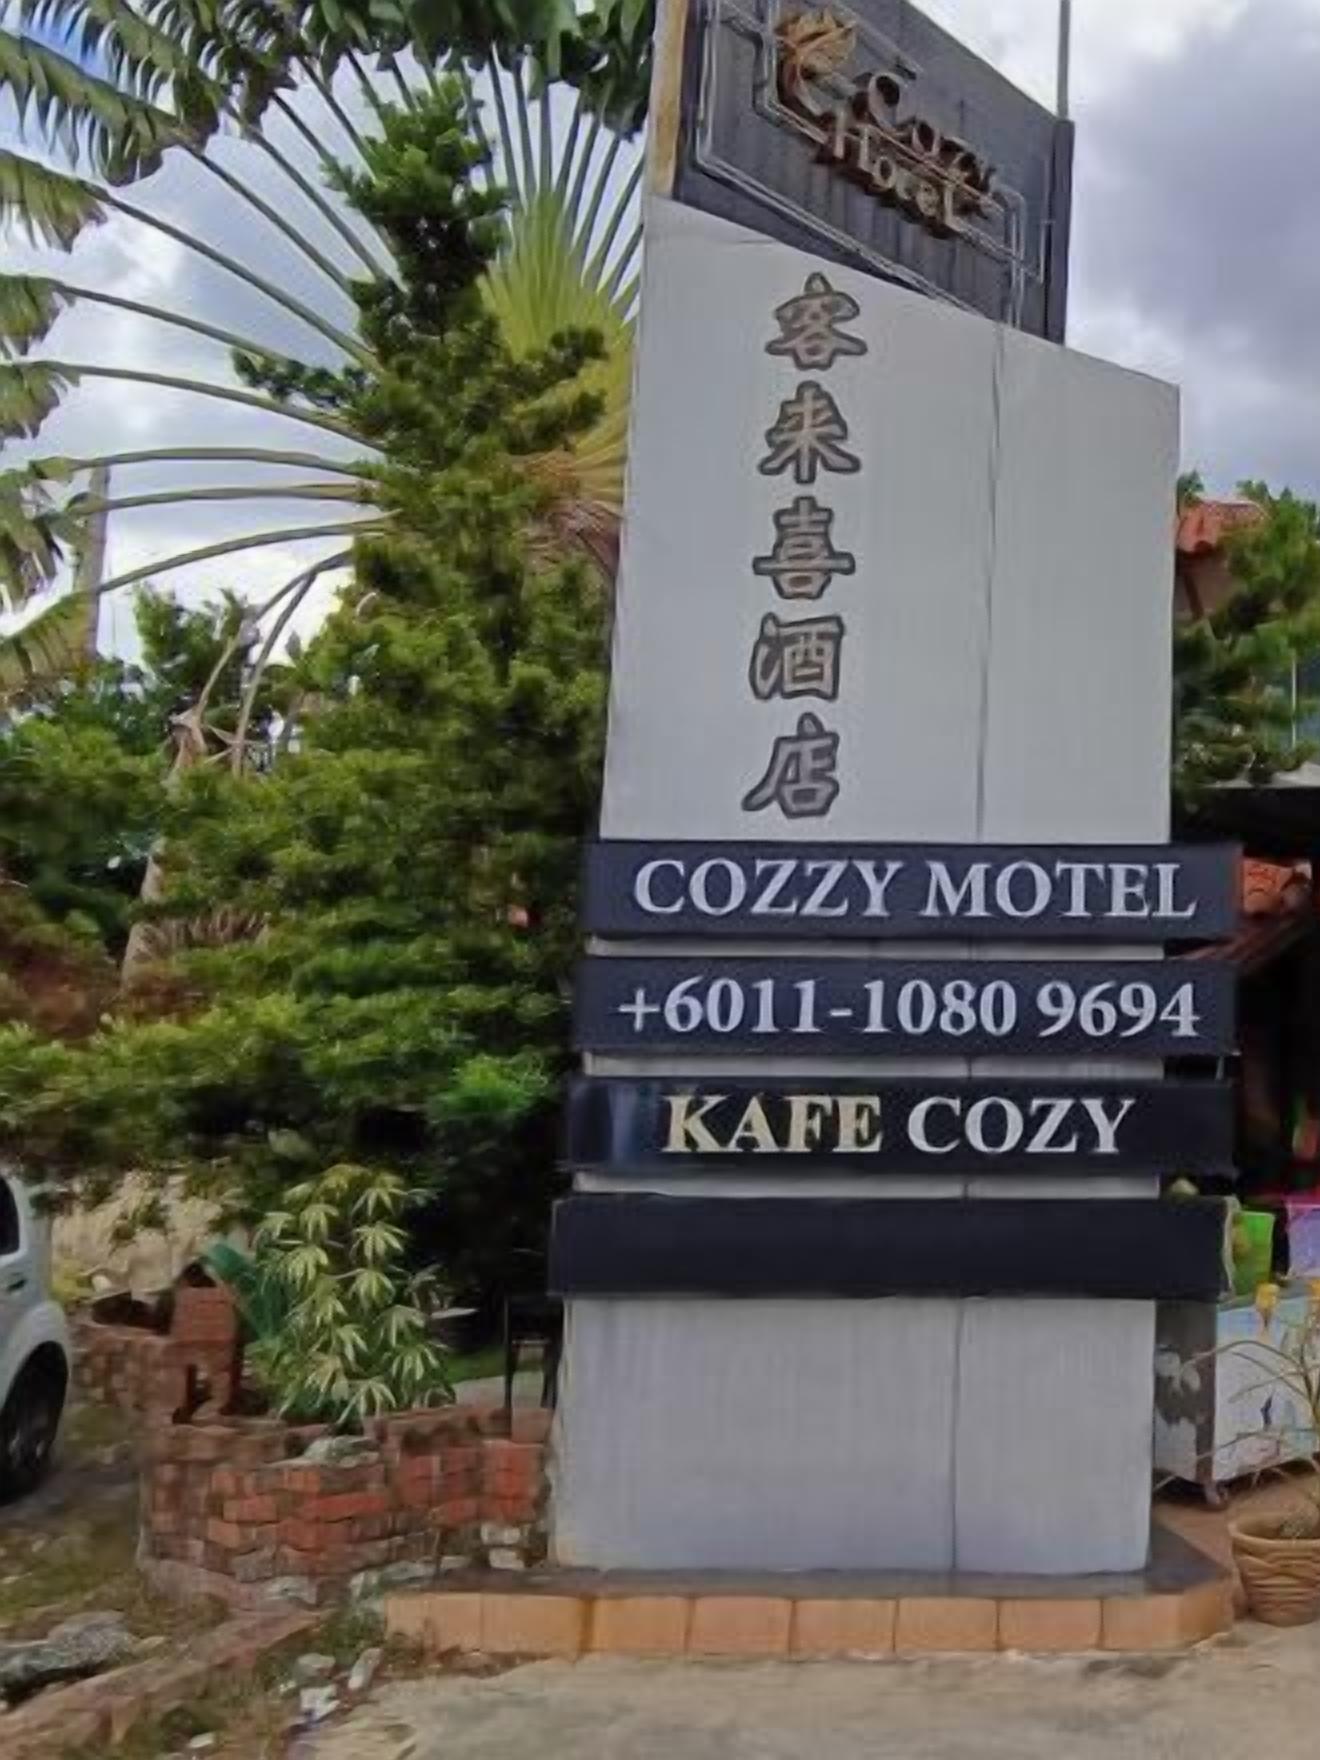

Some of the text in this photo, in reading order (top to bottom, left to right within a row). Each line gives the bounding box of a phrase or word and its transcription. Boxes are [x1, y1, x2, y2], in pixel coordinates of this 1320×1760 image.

[741, 271, 868, 819] 客来喜酒店
[633, 857, 1198, 918] COZZY MOTEL
[618, 976, 1200, 1038] +6011-1080 9694
[662, 1094, 1135, 1155] KAFE COZY
